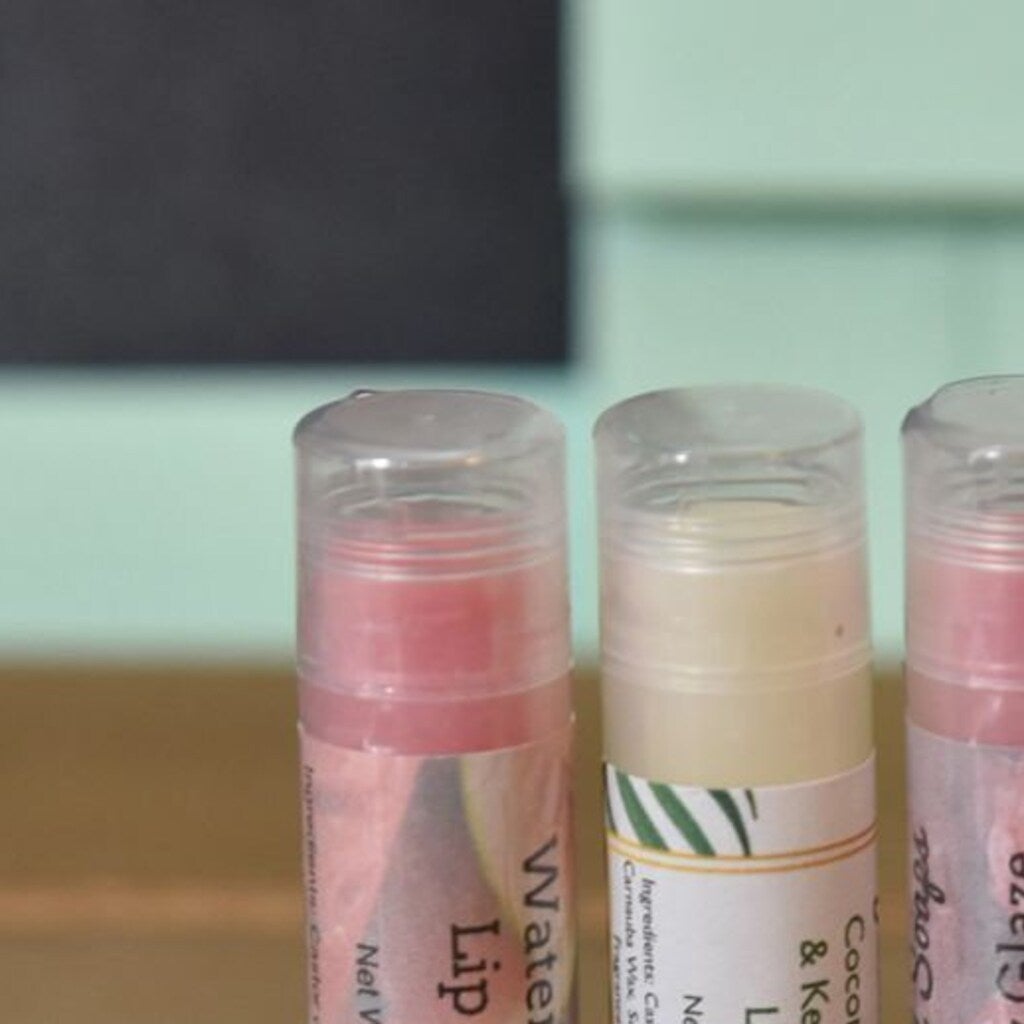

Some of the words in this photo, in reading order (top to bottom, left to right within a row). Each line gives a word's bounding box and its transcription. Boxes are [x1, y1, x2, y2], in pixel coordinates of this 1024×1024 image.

[622, 859, 638, 950] Carnauba
[639, 877, 660, 988] Ingredients:
[911, 826, 946, 1000] Soaps
[354, 942, 380, 996] Net
[438, 921, 501, 1017] Lip
[798, 938, 828, 969] &
